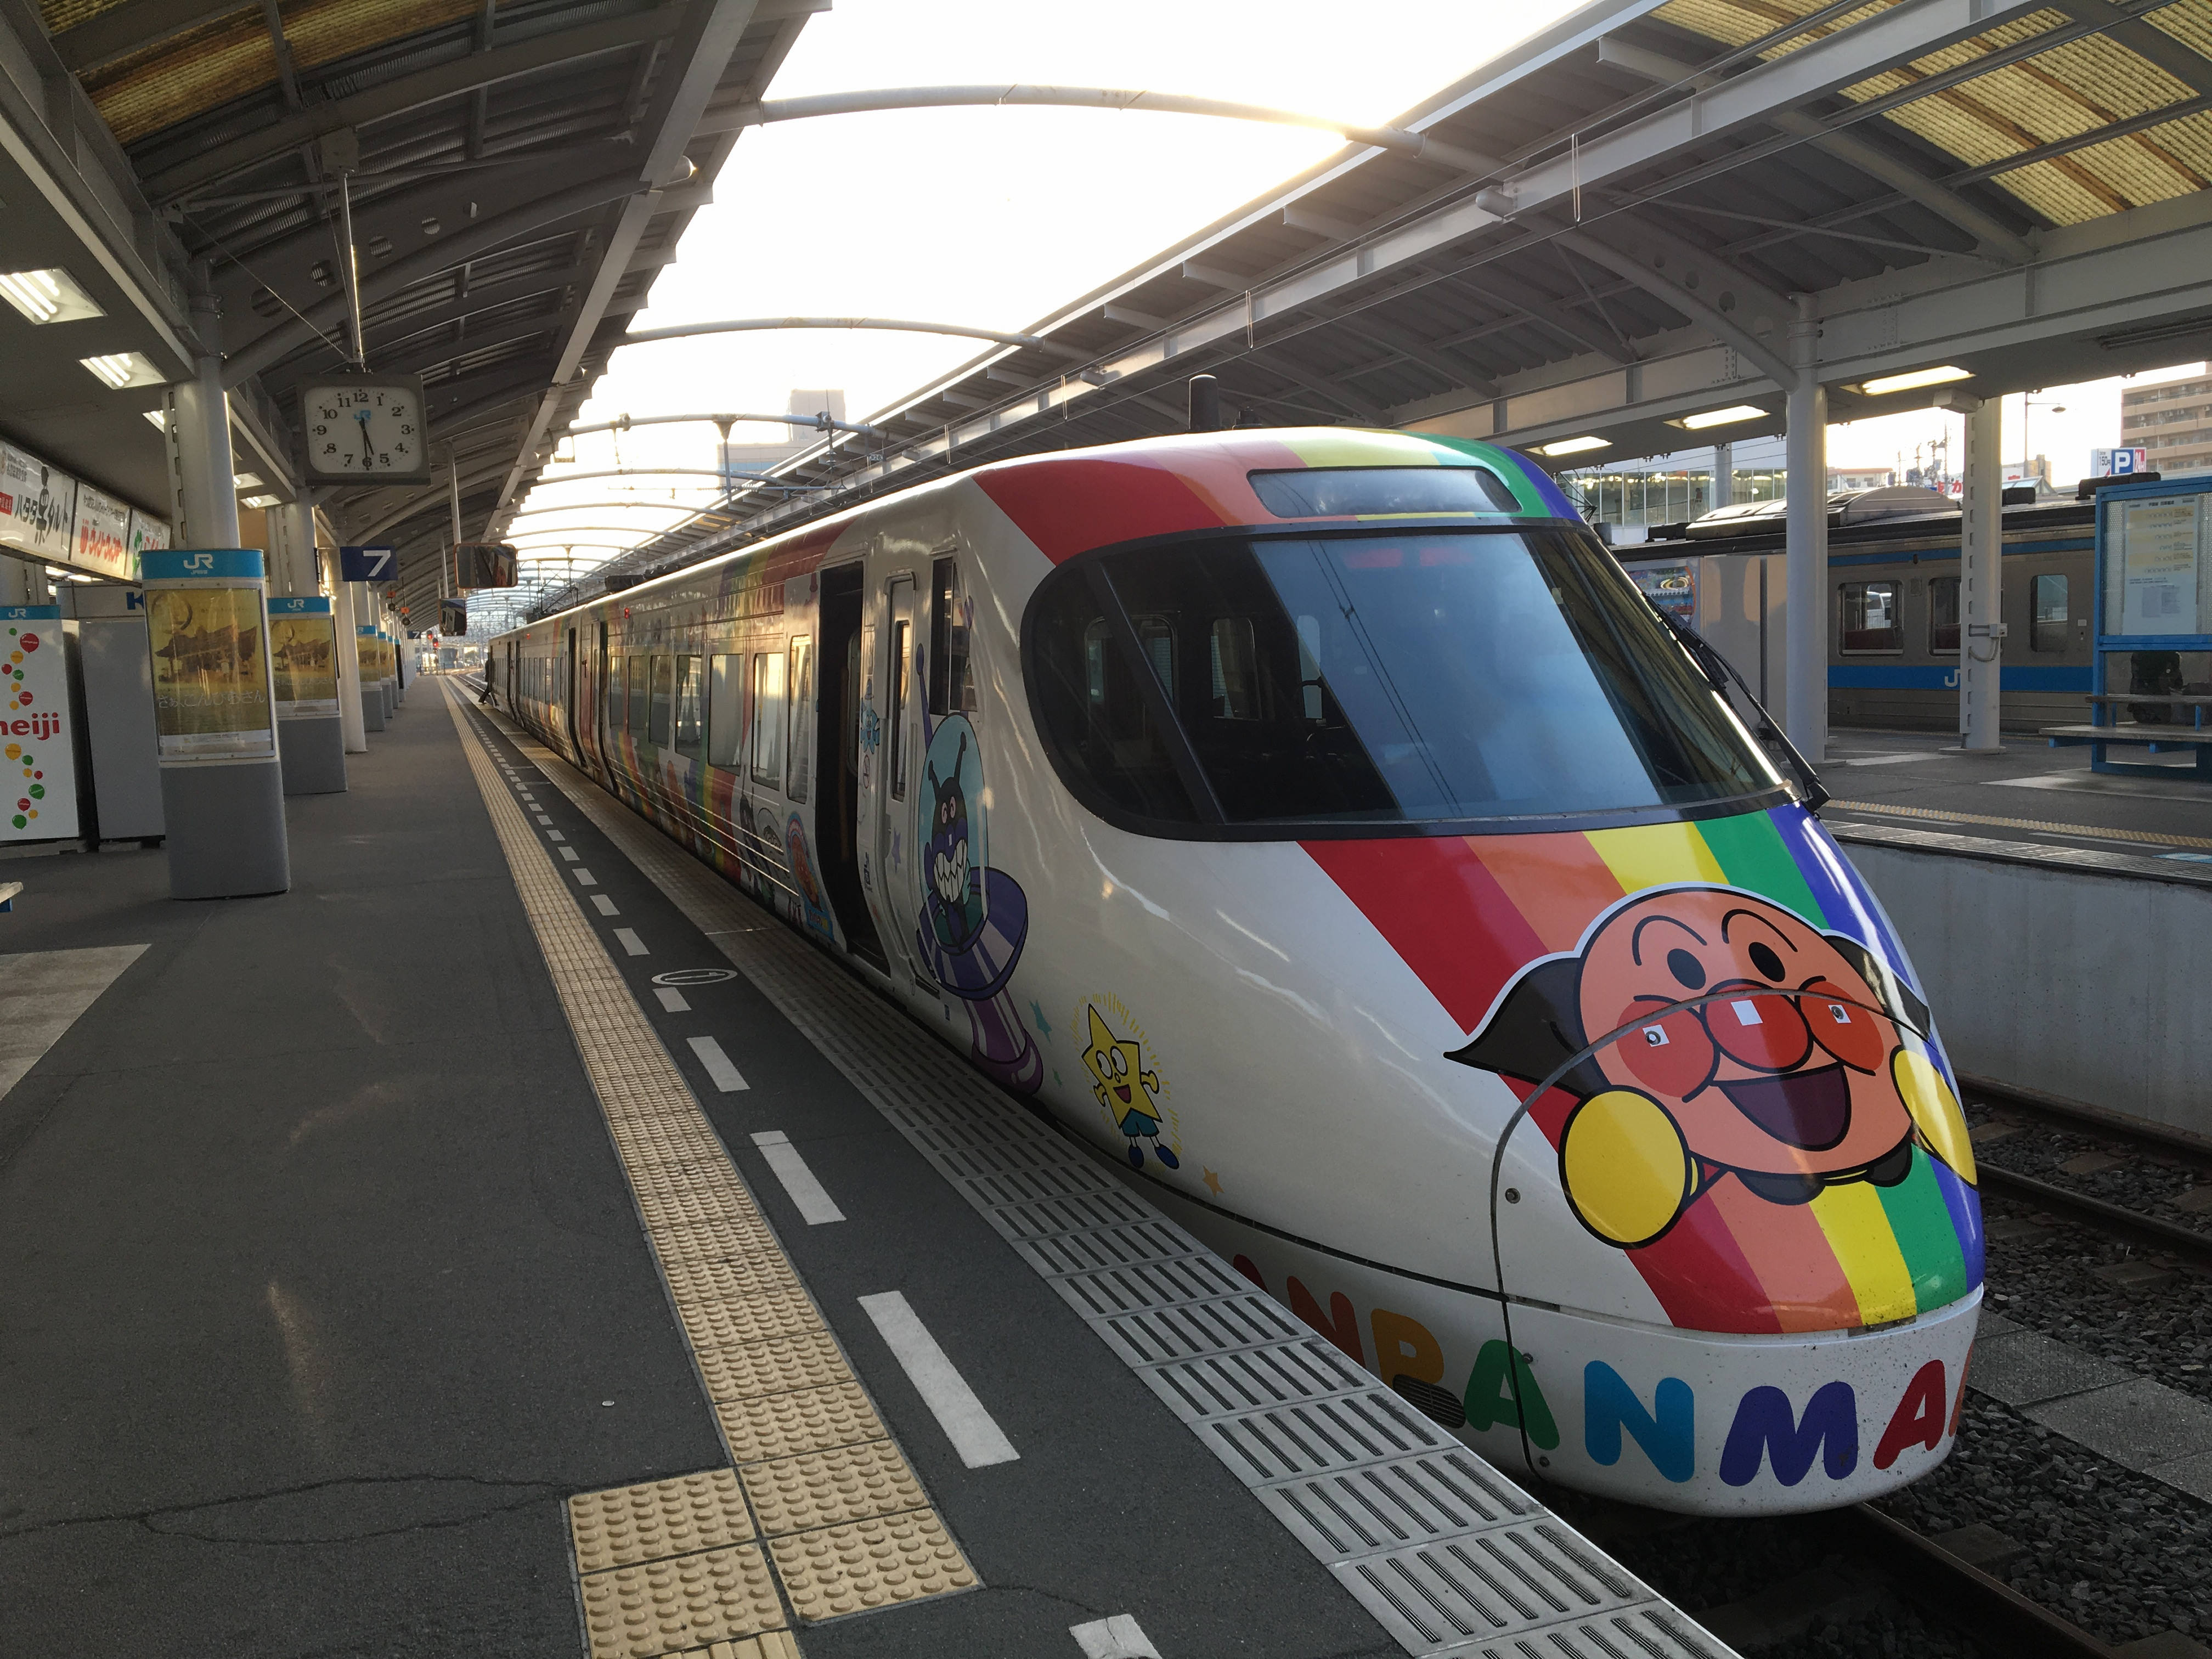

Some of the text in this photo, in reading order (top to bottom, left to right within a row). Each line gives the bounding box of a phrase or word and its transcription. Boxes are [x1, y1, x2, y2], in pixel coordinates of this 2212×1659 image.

[337, 397, 351, 407] 11
[353, 392, 369, 402] 12
[377, 396, 382, 406] 1
[323, 409, 338, 419] 10
[392, 407, 402, 416] 2
[317, 425, 327, 435] 9
[401, 425, 411, 435] 3
[326, 443, 336, 453] 8
[394, 443, 404, 452] 4
[344, 454, 353, 464] 7
[362, 456, 372, 467] 6
[380, 453, 389, 463] 5
[2115, 452, 2130, 473] P
[183, 554, 213, 569] JR
[363, 550, 391, 577] 7
[287, 599, 304, 608] JR
[9, 608, 26, 618] JR
[1944, 669, 1961, 687] J
[0, 712, 60, 741] eiji
